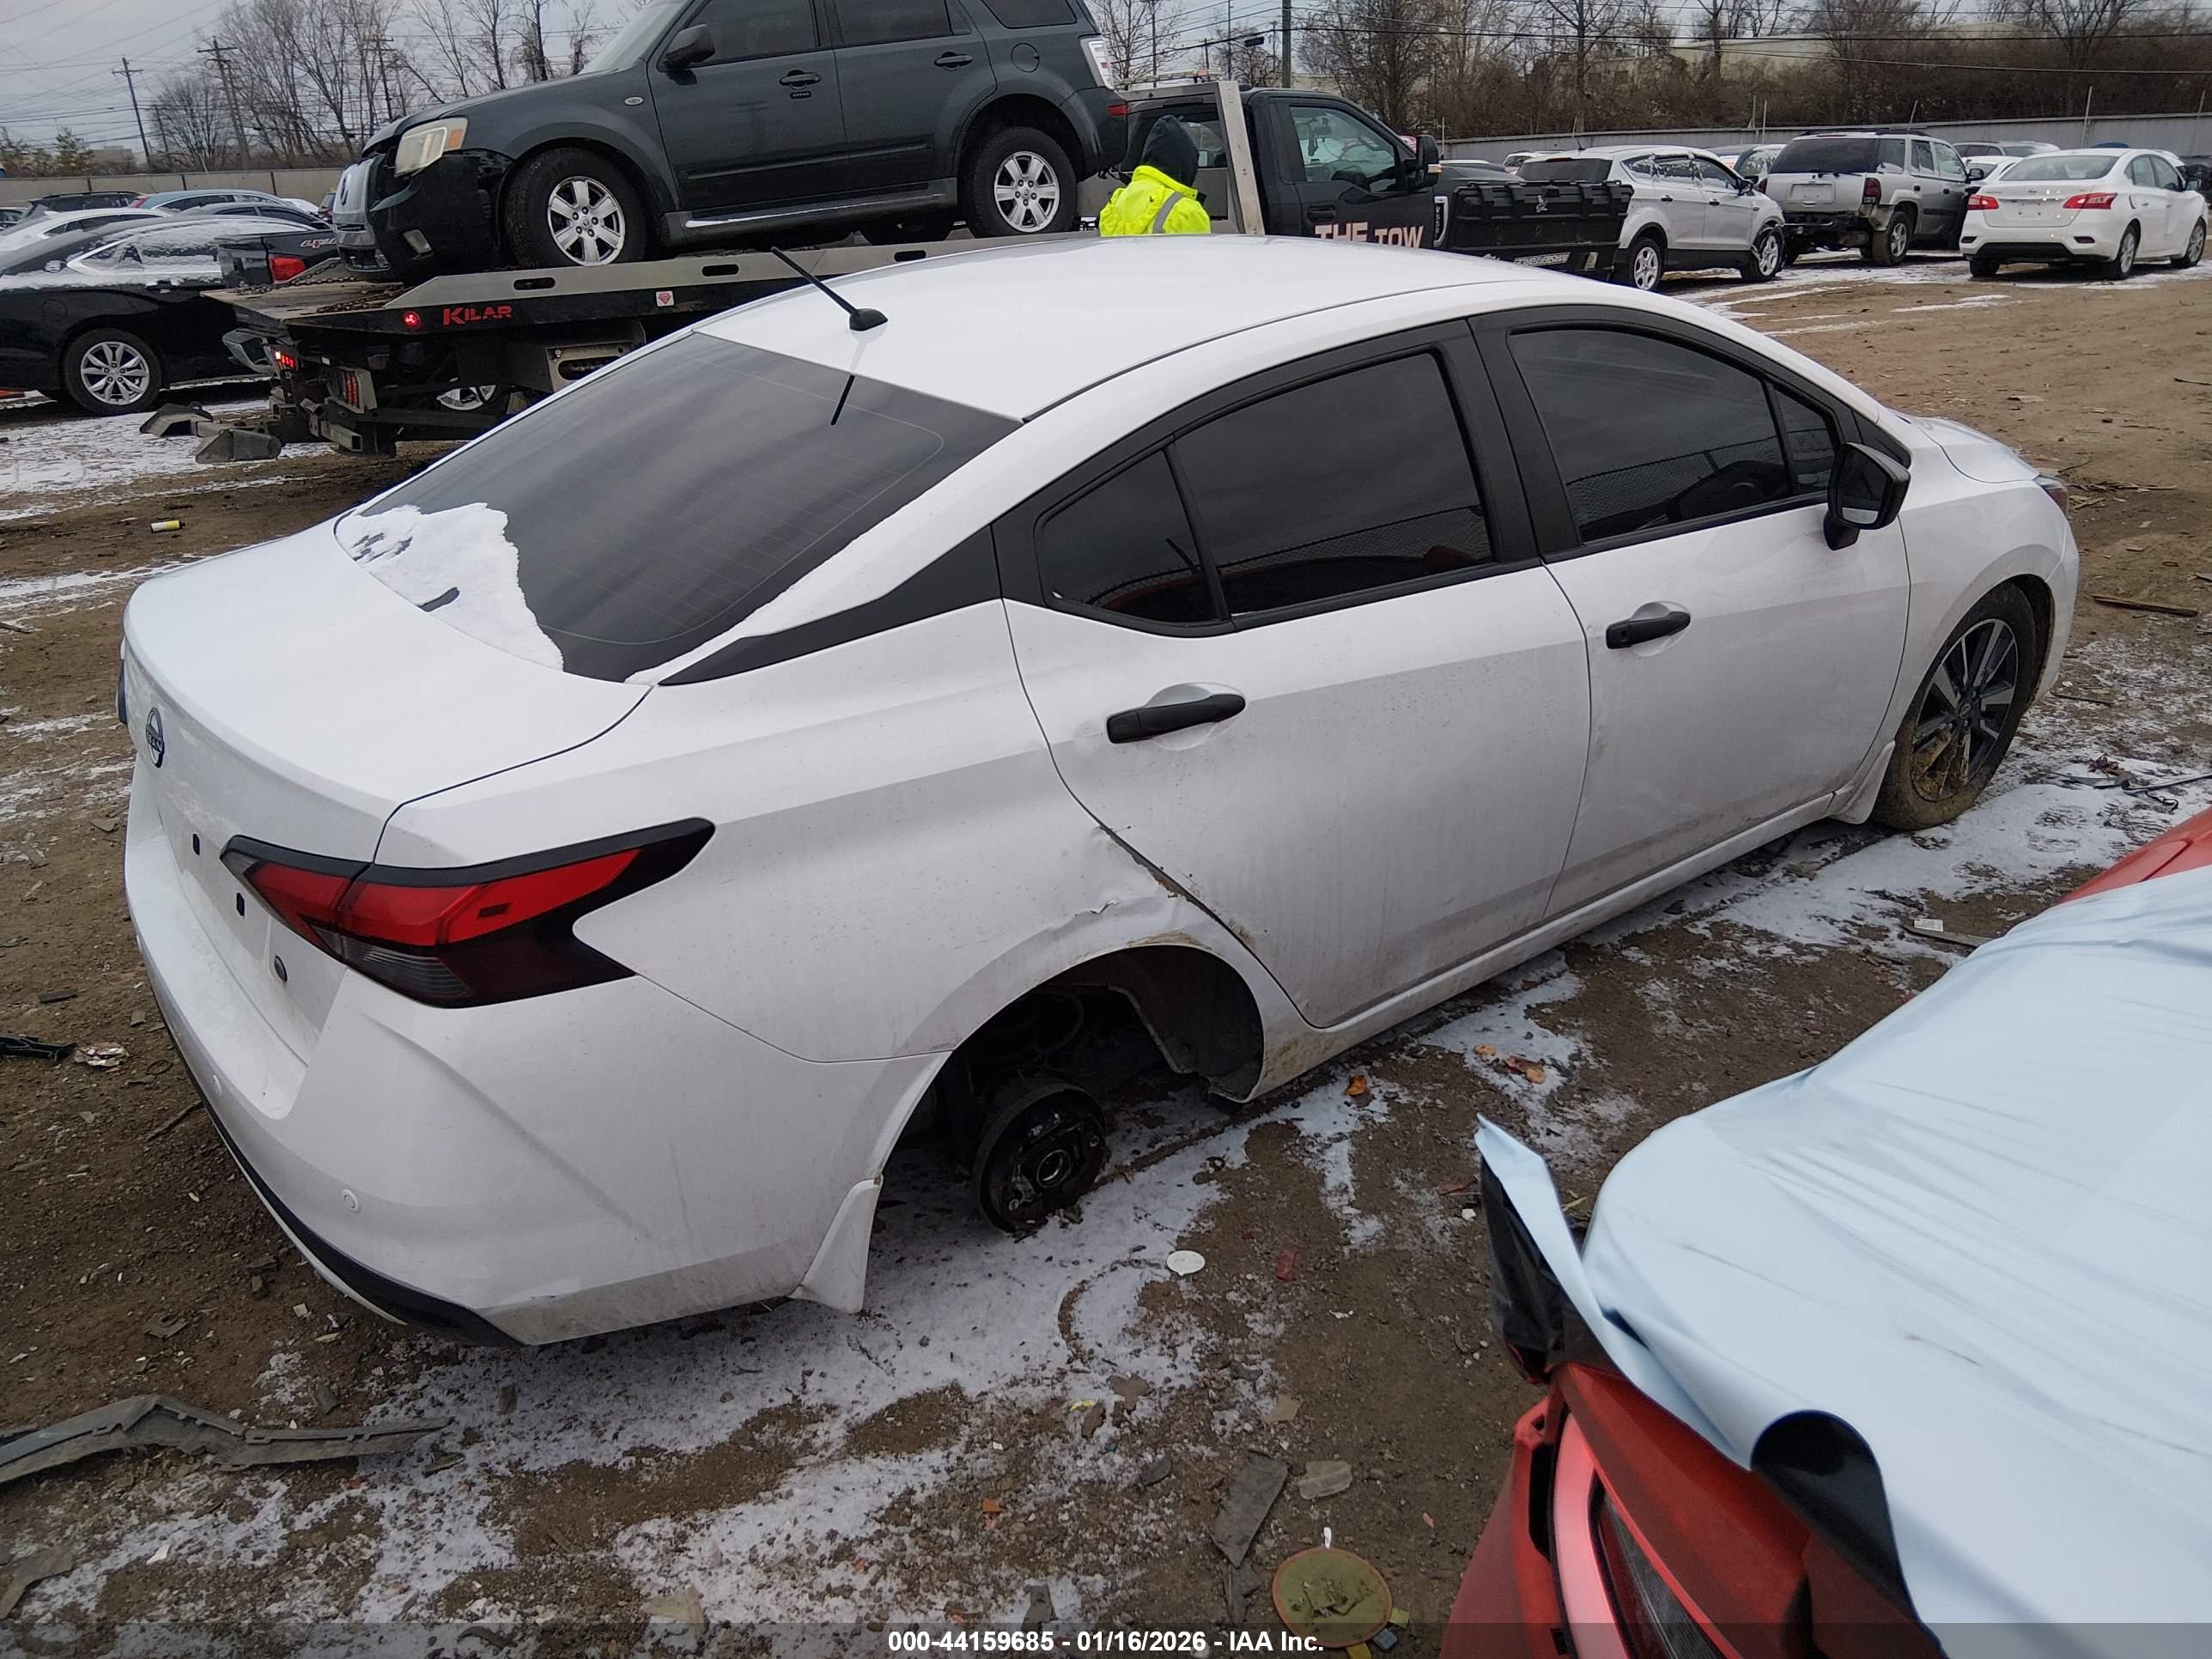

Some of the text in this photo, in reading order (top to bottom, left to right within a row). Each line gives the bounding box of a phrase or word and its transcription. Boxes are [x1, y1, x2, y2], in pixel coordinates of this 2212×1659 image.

[1315, 222, 1424, 248] THE TOW
[443, 306, 513, 325] KILAR
